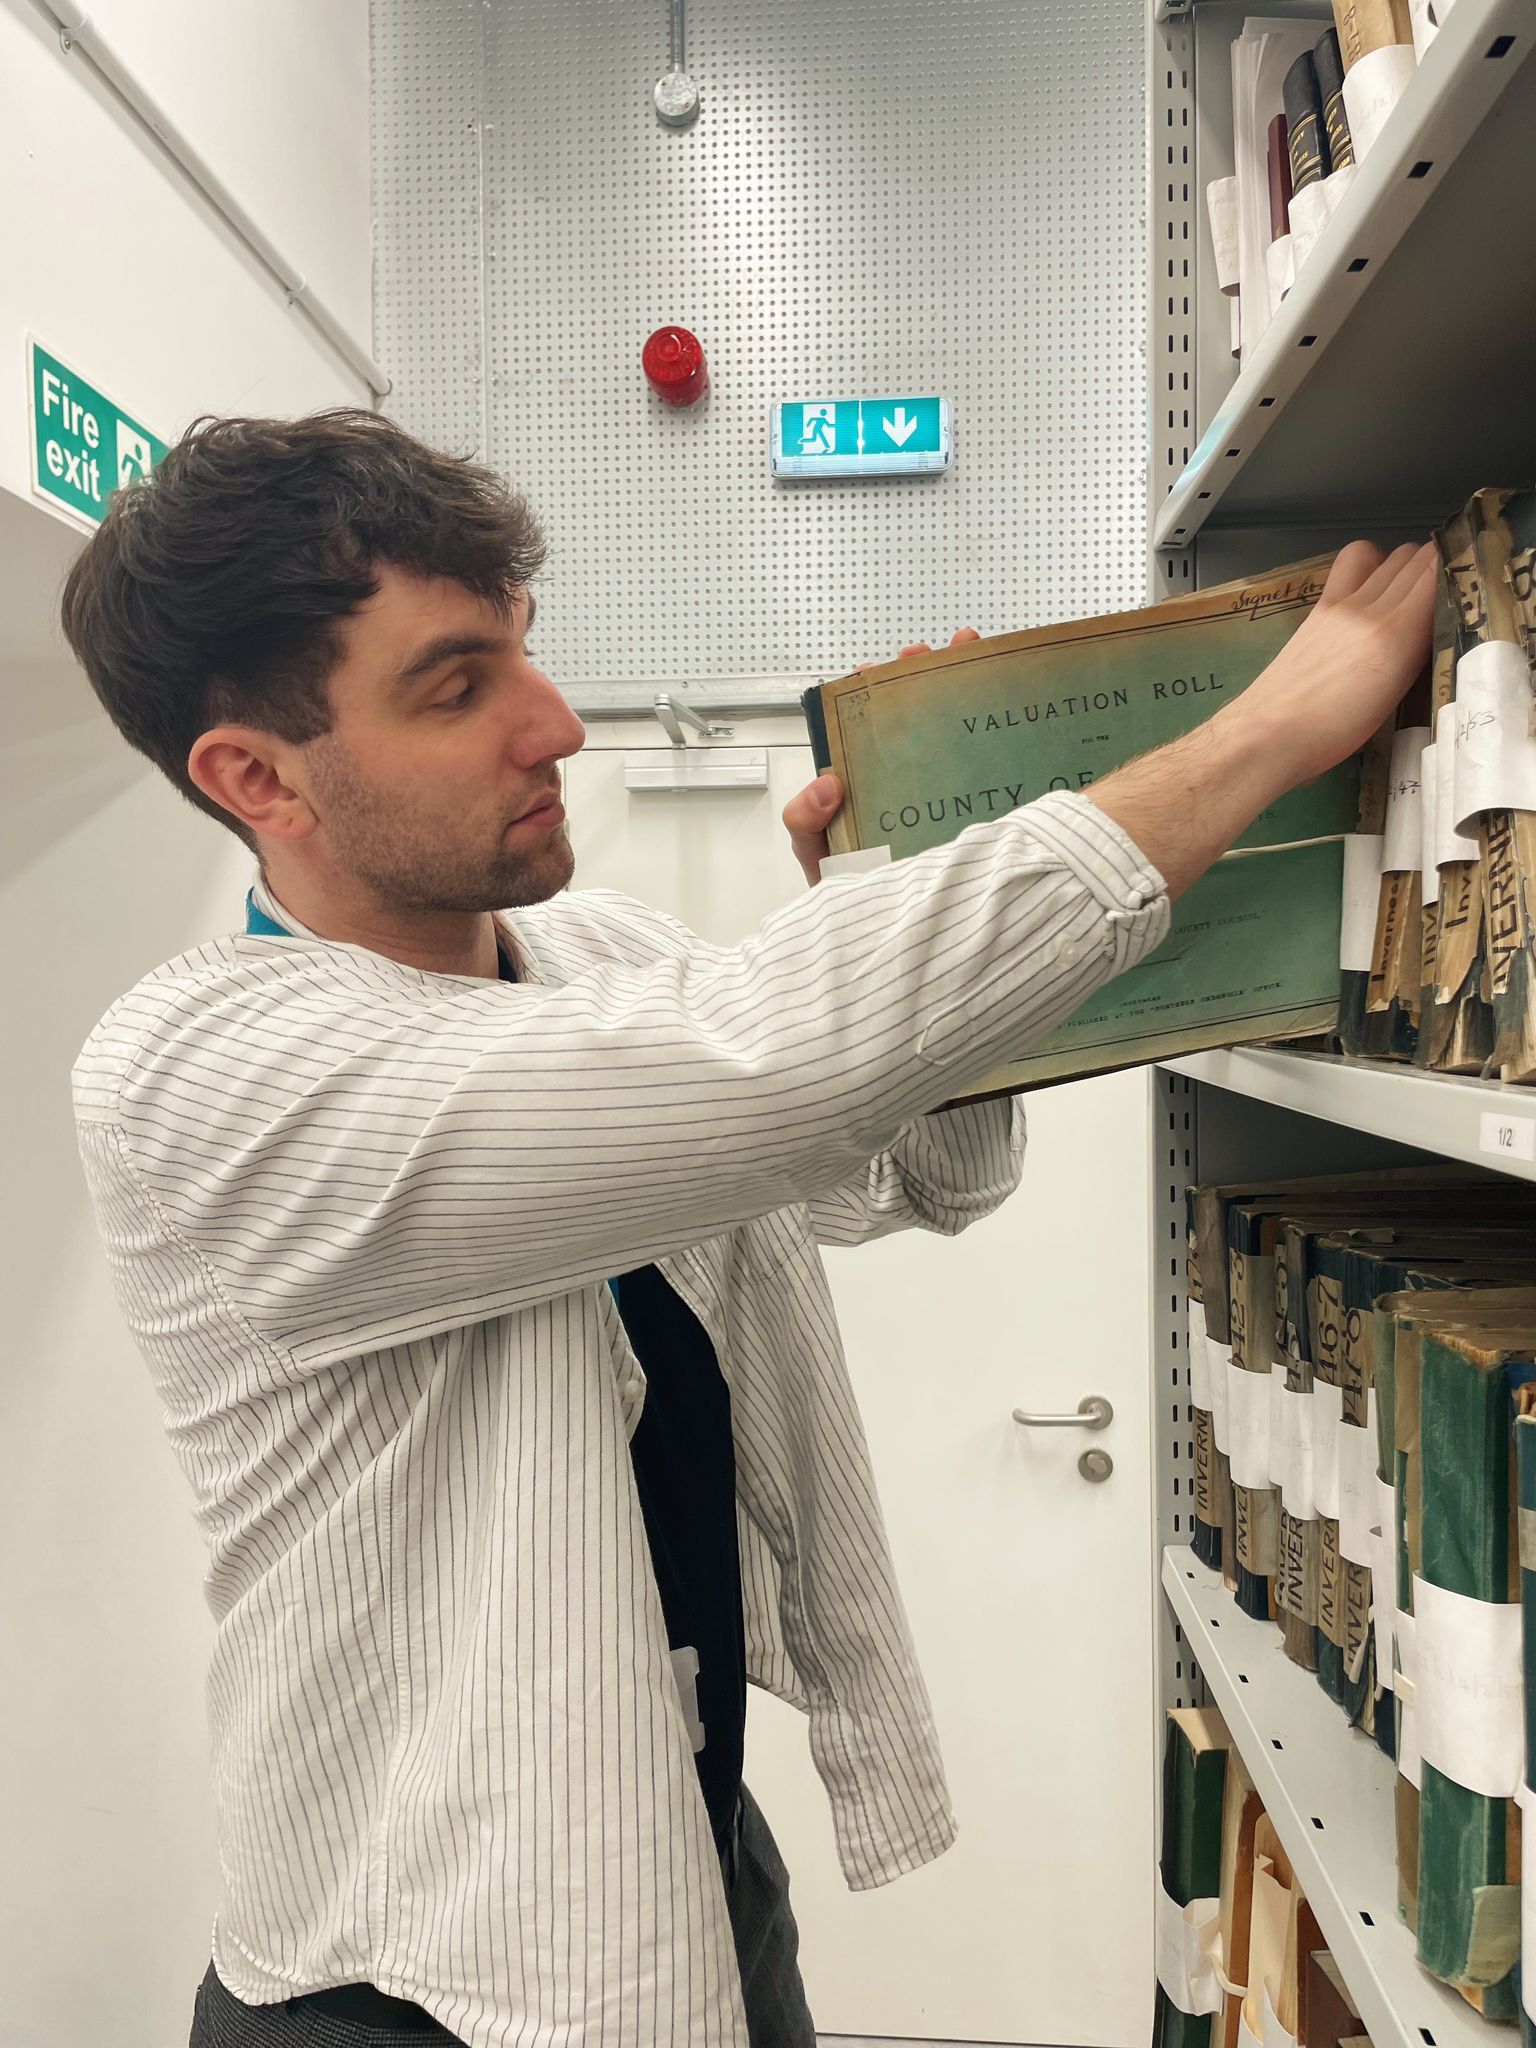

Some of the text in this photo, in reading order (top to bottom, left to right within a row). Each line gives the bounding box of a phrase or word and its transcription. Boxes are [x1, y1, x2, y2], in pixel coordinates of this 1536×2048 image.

[42, 368, 100, 449] Fire
[46, 439, 101, 502] exit
[963, 673, 1224, 734] VALUATION ROLL
[879, 771, 1094, 832] COUNTY OF
[1498, 1127, 1512, 1147] 1/2
